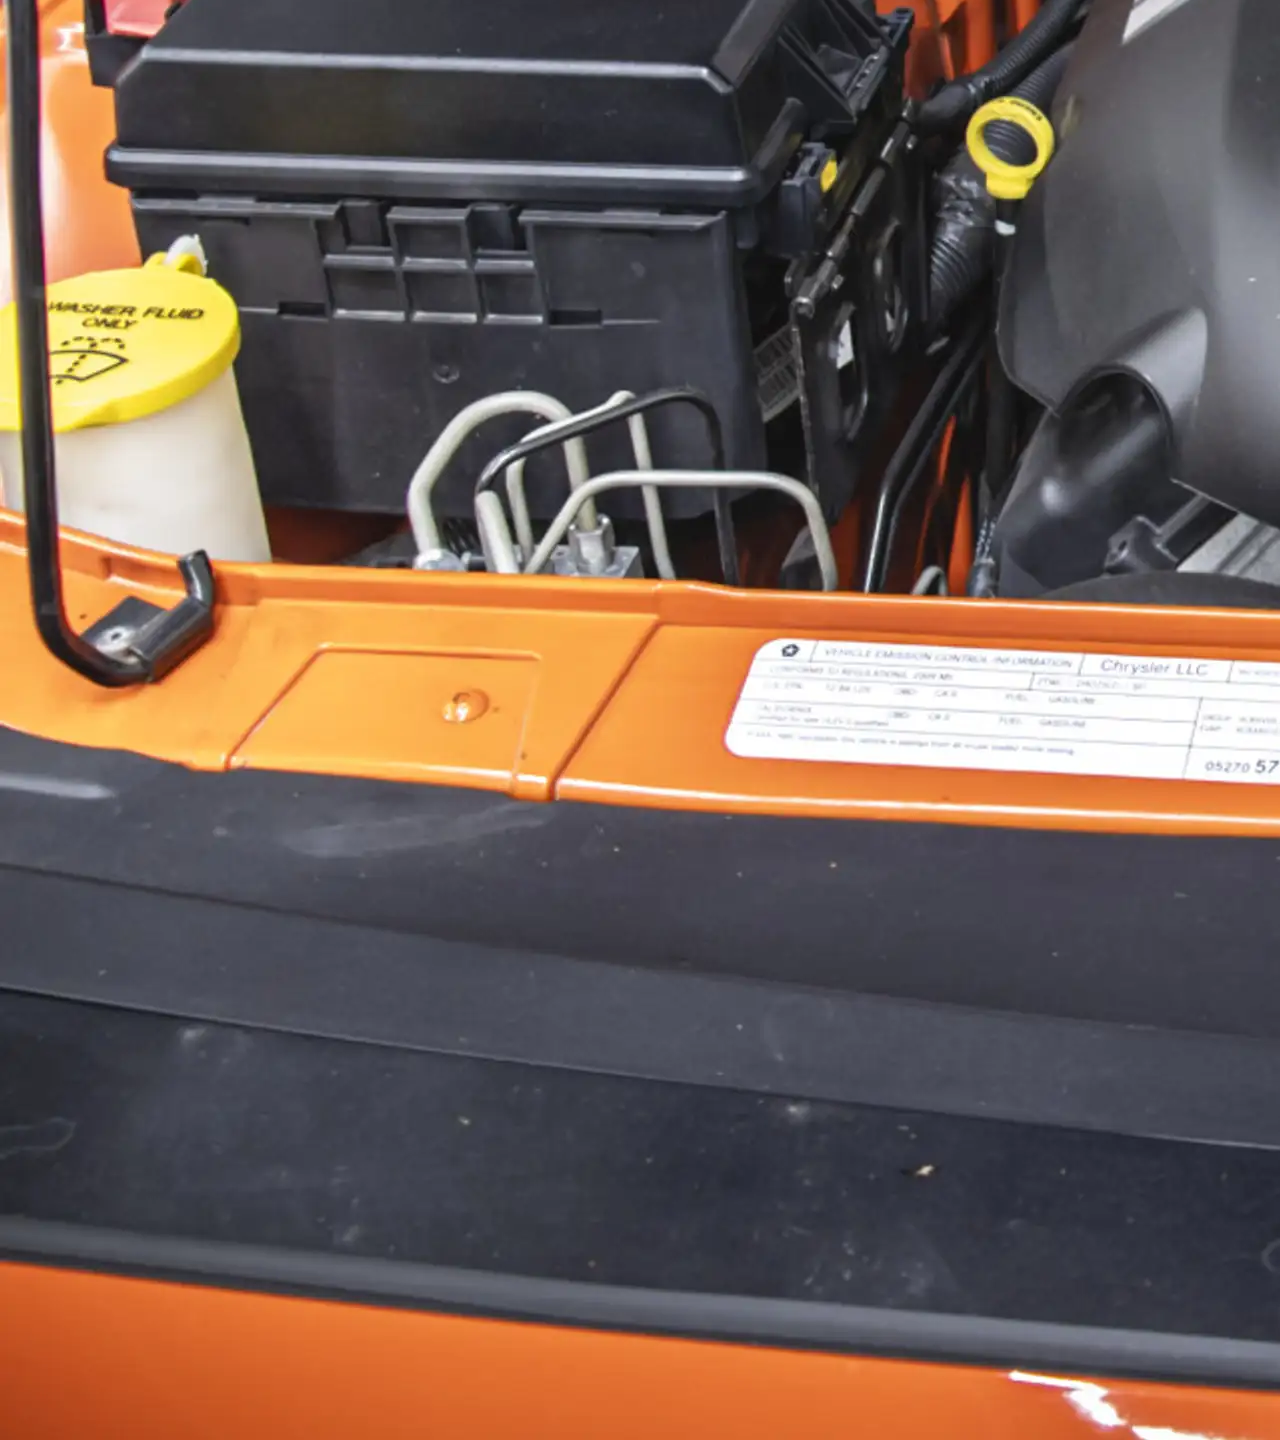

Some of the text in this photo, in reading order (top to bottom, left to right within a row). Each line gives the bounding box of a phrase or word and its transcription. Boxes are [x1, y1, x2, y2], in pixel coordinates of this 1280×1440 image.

[143, 306, 205, 320] FLUID
[81, 316, 138, 329] ONLY
[1100, 658, 1209, 677] Chrysler LLC
